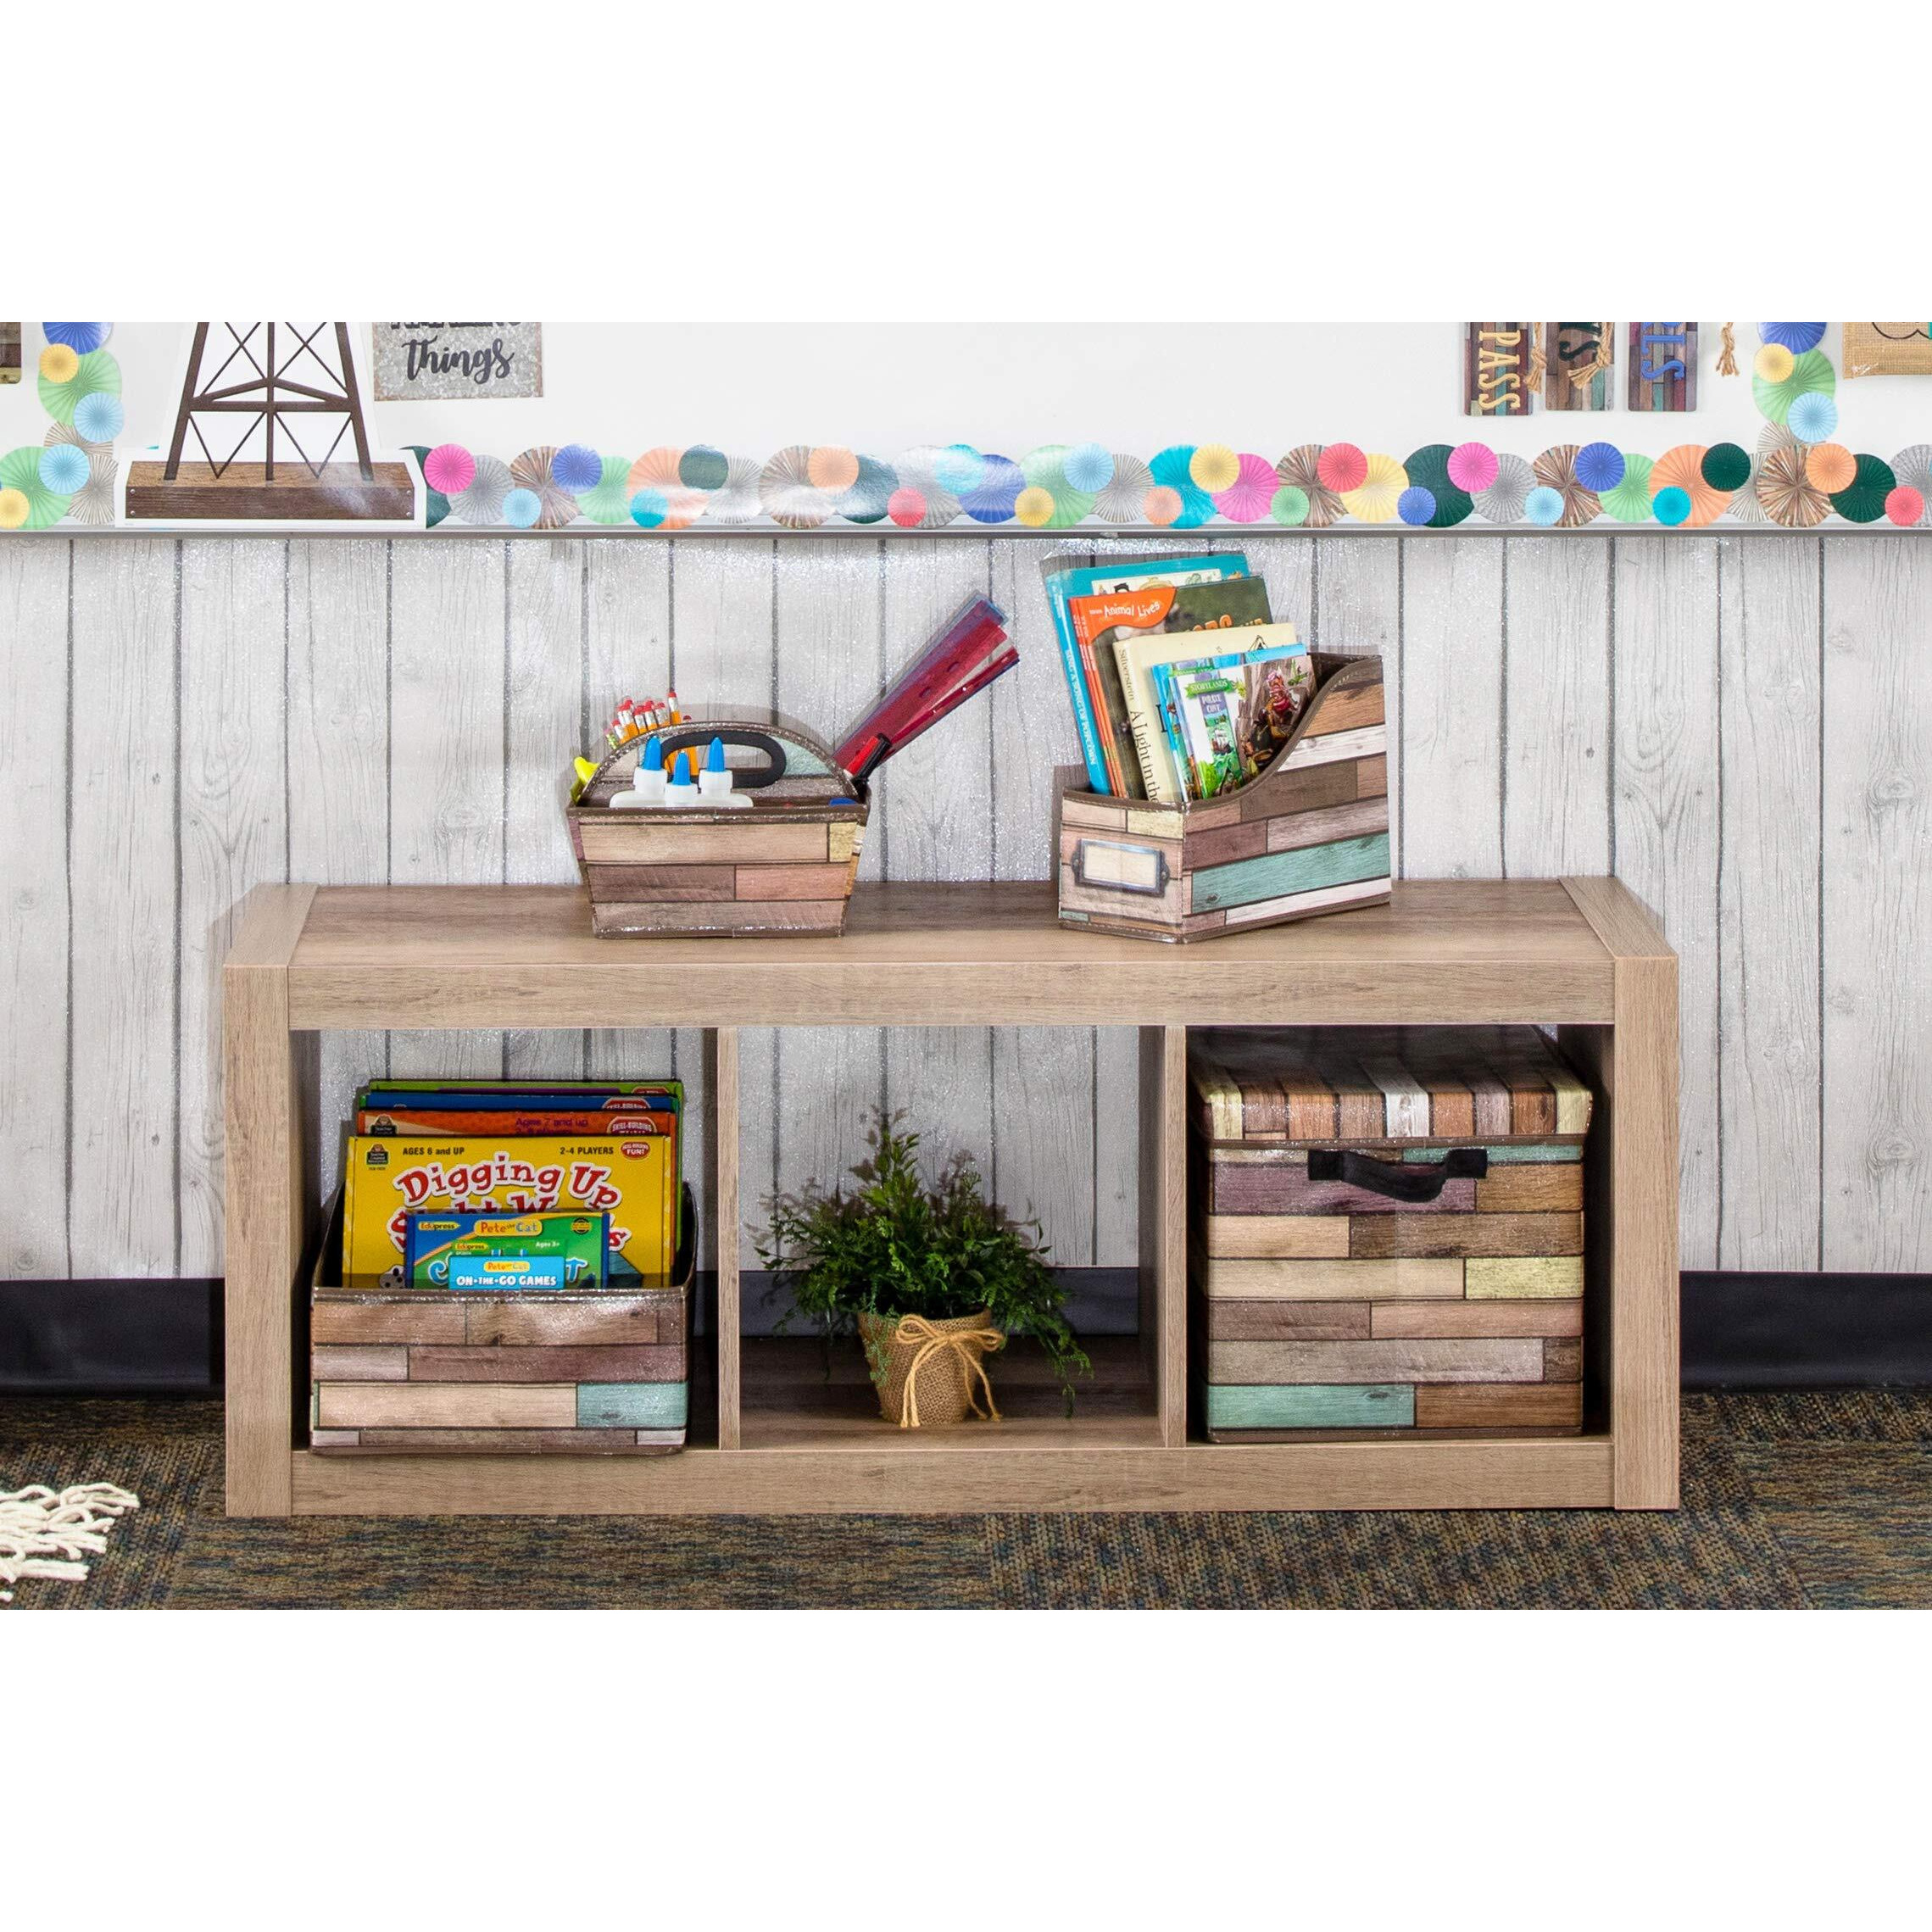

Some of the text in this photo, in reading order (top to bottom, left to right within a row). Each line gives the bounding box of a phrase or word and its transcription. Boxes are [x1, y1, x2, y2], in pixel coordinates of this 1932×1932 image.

[1478, 330, 1522, 410] PASS
[1104, 600, 1161, 618] Animal Lives
[1119, 649, 1135, 701] Silverstein
[1130, 710, 1145, 721] A
[1130, 722, 1150, 761] Light
[1143, 761, 1155, 780] in
[403, 1147, 465, 1155] AGES 6 and UP
[560, 1146, 614, 1155] 2-4 PLAYERS
[396, 1154, 565, 1204] Digging
[572, 1164, 620, 1210] Up
[420, 1222, 456, 1231] Edupress
[481, 1222, 506, 1233] Pete
[515, 1222, 537, 1233] Cat
[487, 1262, 506, 1271] Pete
[519, 1275, 557, 1286] GAMES
